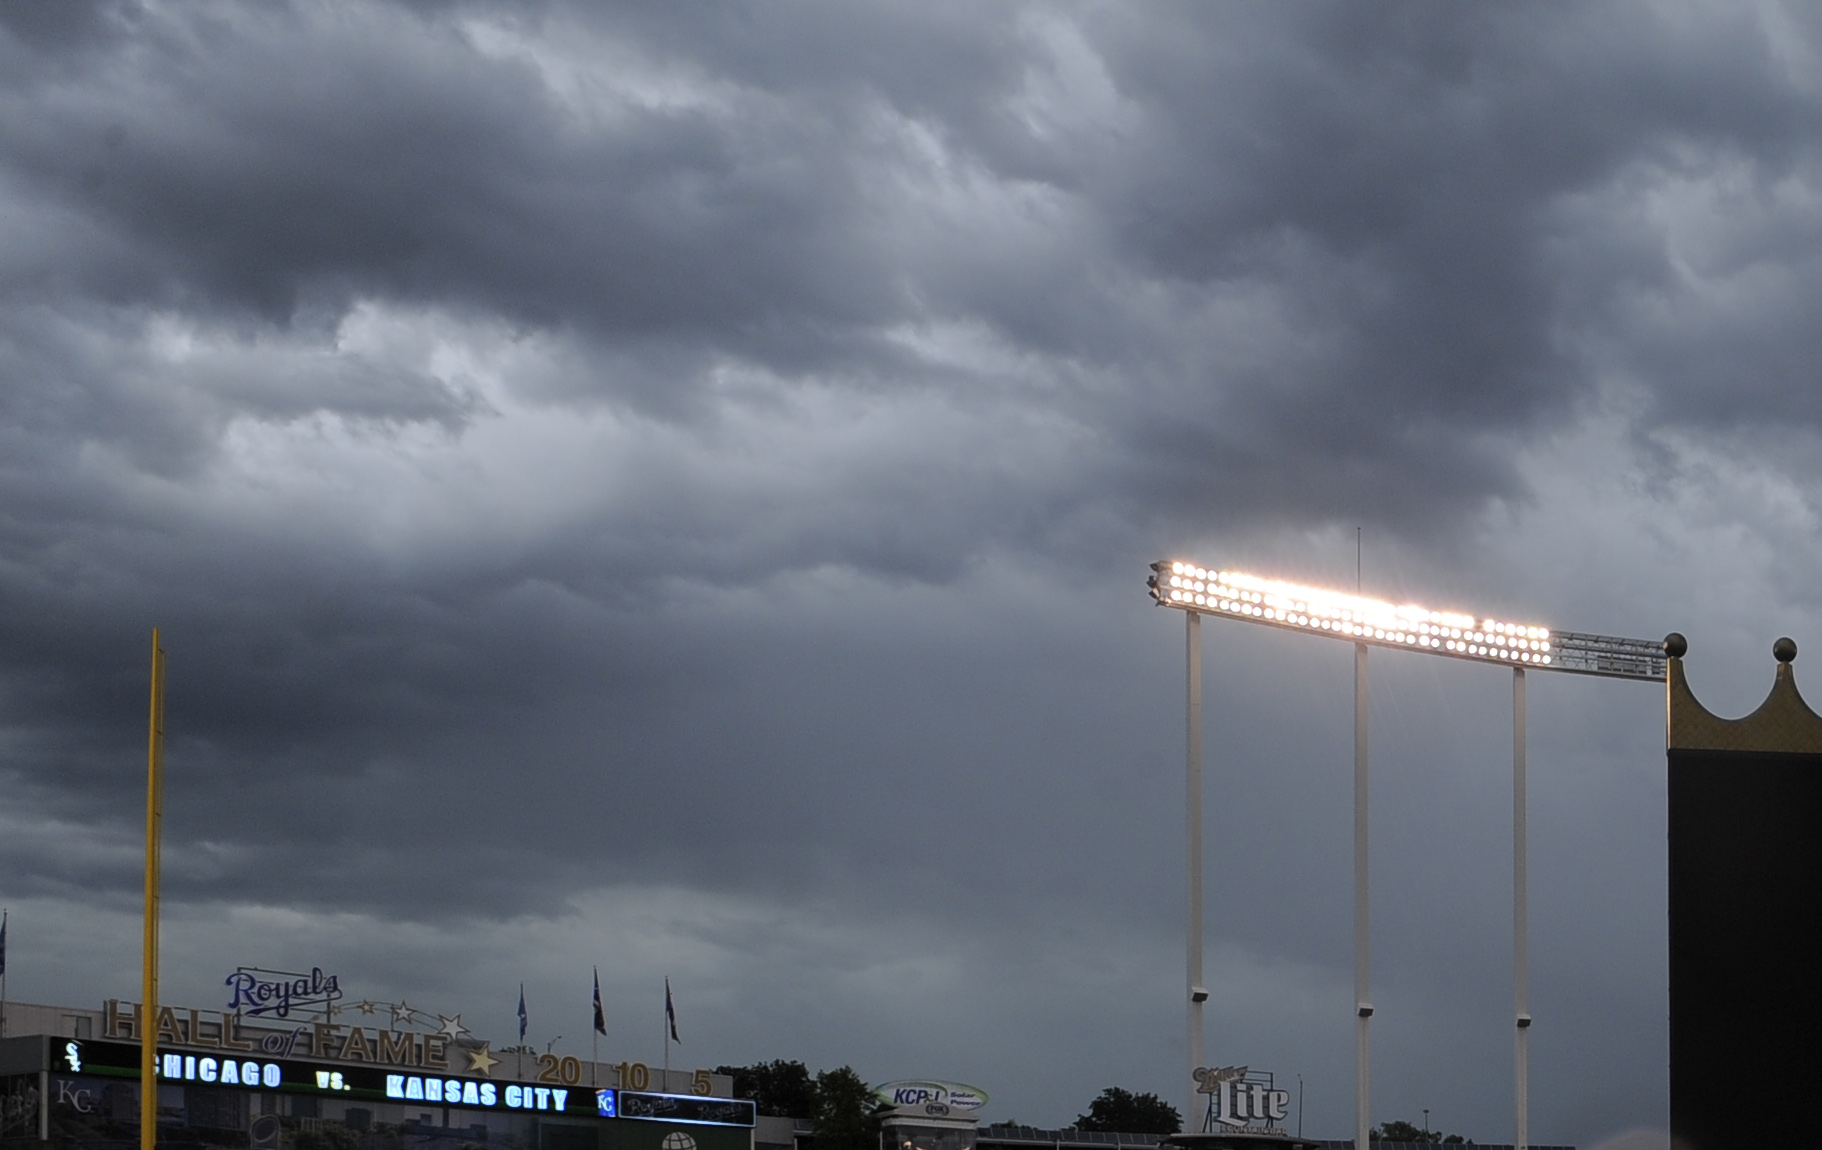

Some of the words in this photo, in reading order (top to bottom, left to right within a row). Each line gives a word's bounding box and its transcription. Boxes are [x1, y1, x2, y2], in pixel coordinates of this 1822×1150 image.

[226, 967, 342, 1017] Royals
[104, 999, 252, 1050] HALL
[263, 1027, 309, 1060] of
[312, 1022, 450, 1071] FAME
[537, 1054, 583, 1086] 20
[615, 1061, 650, 1091] 10
[691, 1069, 714, 1097] 5
[57, 1080, 95, 1114] KC
[386, 1074, 498, 1107] KANSAS
[504, 1084, 570, 1113] CITY
[1213, 1080, 1290, 1128] Lite
